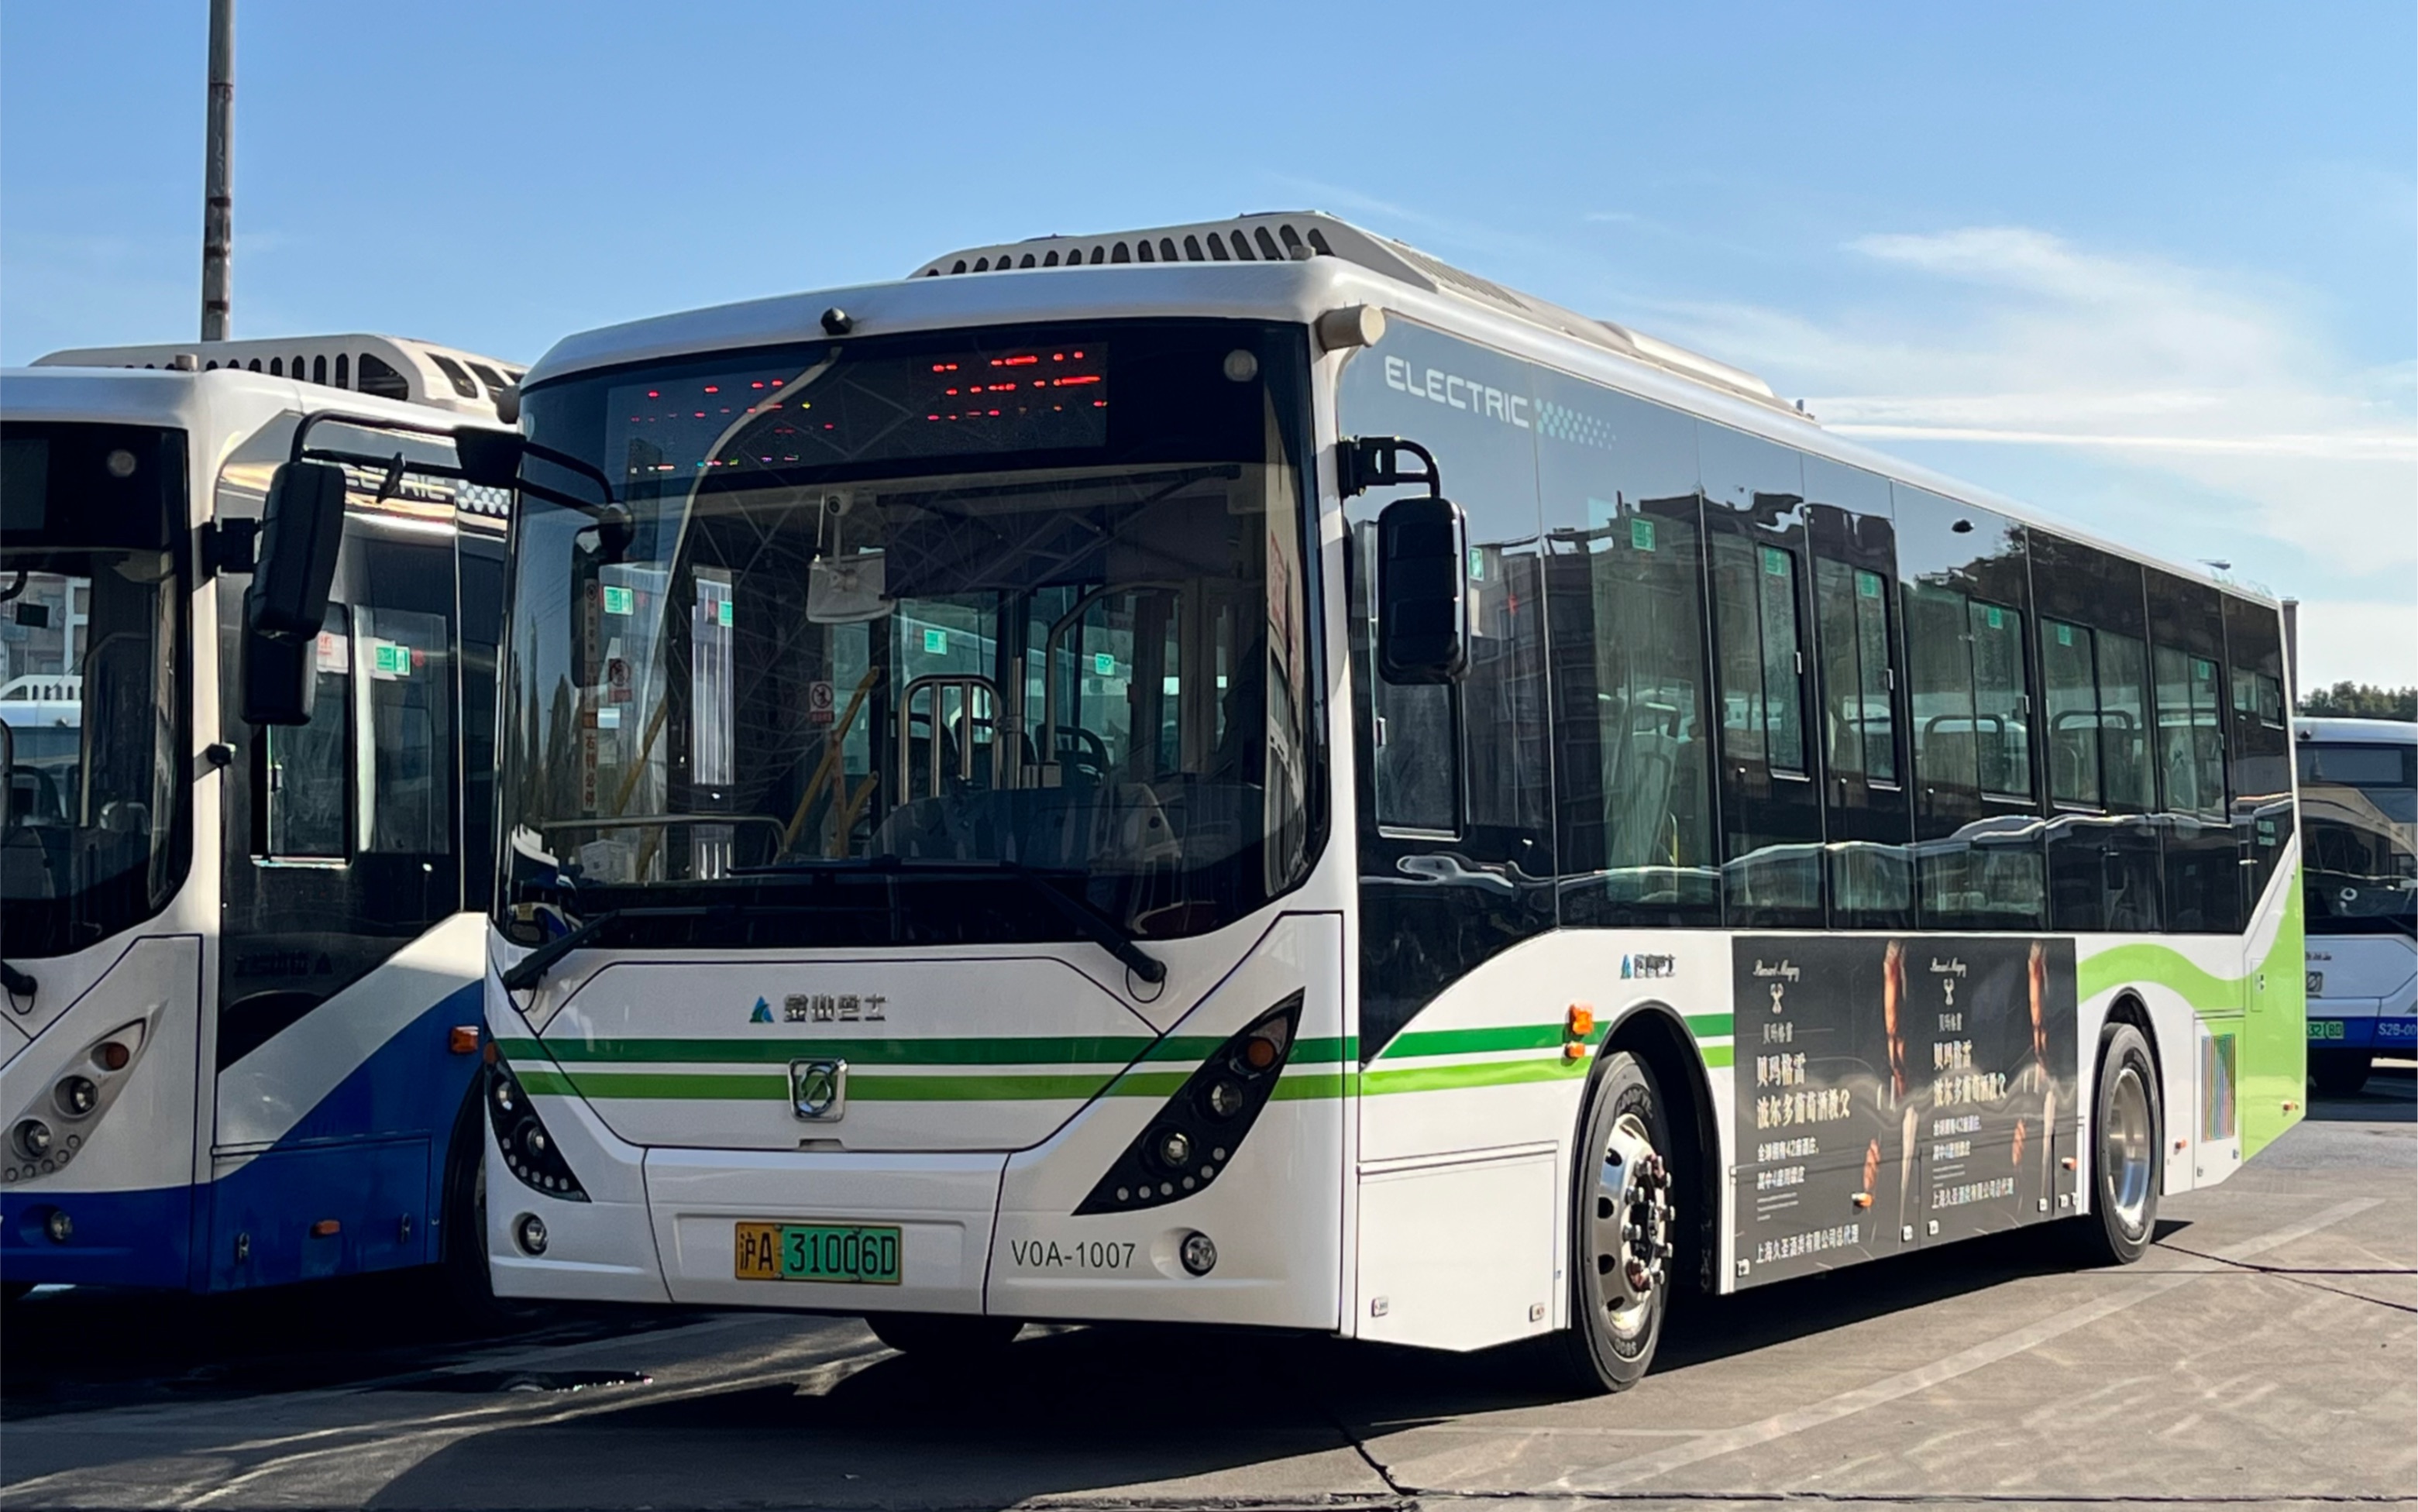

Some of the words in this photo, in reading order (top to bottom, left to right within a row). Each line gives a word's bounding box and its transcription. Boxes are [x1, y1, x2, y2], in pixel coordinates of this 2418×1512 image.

[1384, 355, 1529, 428] ELECTRIC
[783, 993, 887, 1023] 金山巴士
[1756, 1052, 1807, 1088] 贝玛格雷
[1933, 1039, 1973, 1070] 贝玛格雷
[1934, 1071, 2007, 1108] 波尔多葡萄酒教父
[1757, 1088, 1851, 1130] 波尔多葡萄酒教父
[1011, 1239, 1136, 1269] V0A-1007
